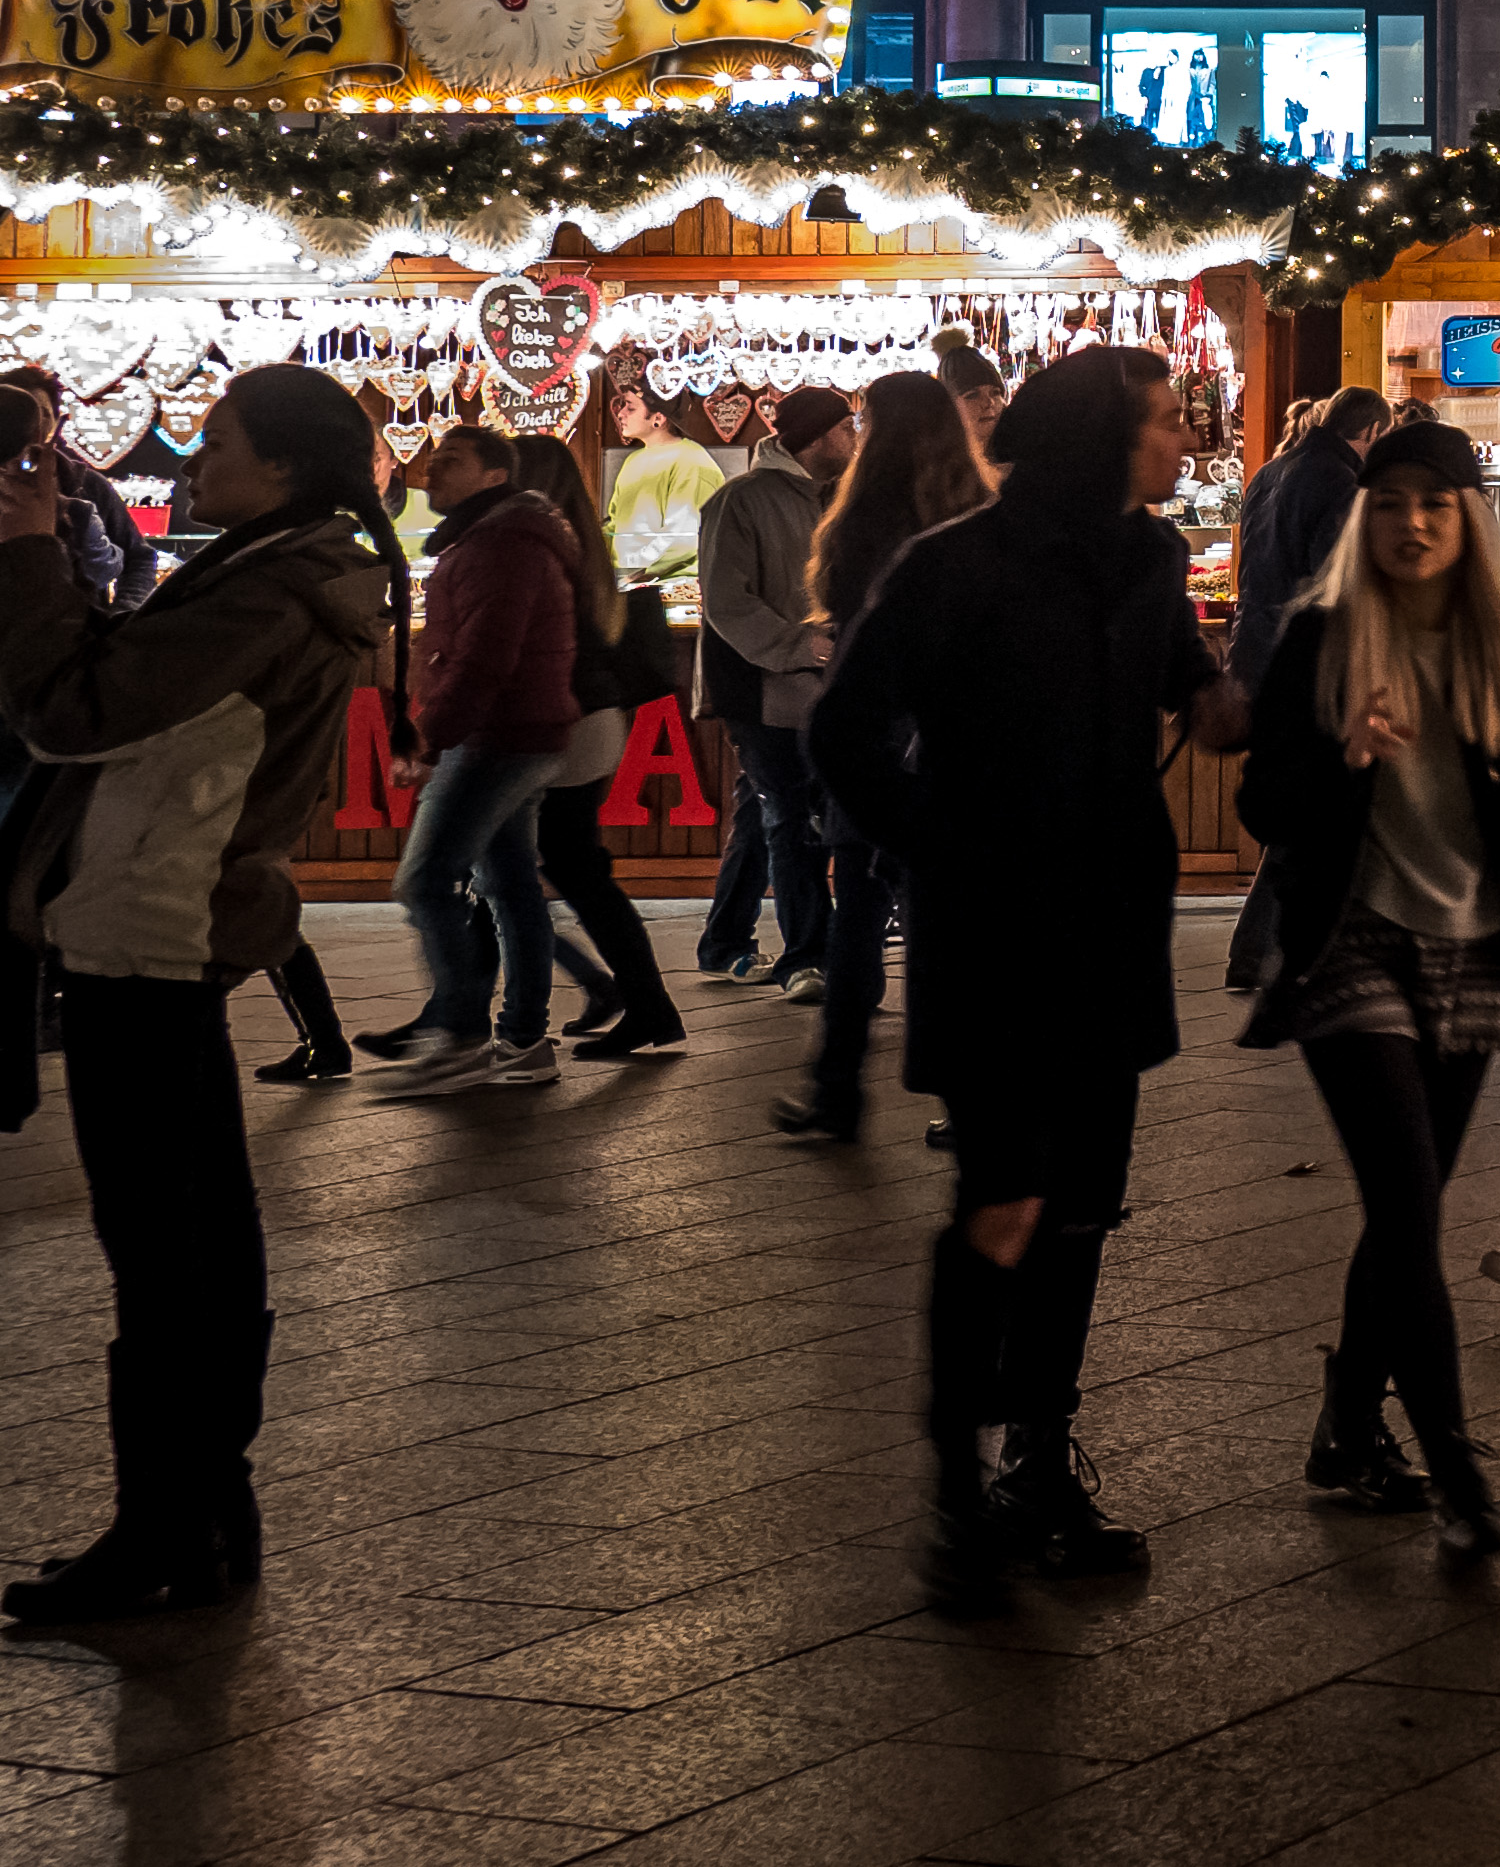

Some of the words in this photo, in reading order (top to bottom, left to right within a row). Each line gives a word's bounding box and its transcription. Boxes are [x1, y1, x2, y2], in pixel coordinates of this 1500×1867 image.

[514, 304, 551, 322] Ich
[512, 324, 555, 346] liebe
[501, 391, 530, 408] Ich
[534, 387, 568, 404] will
[514, 408, 560, 428] Dich!
